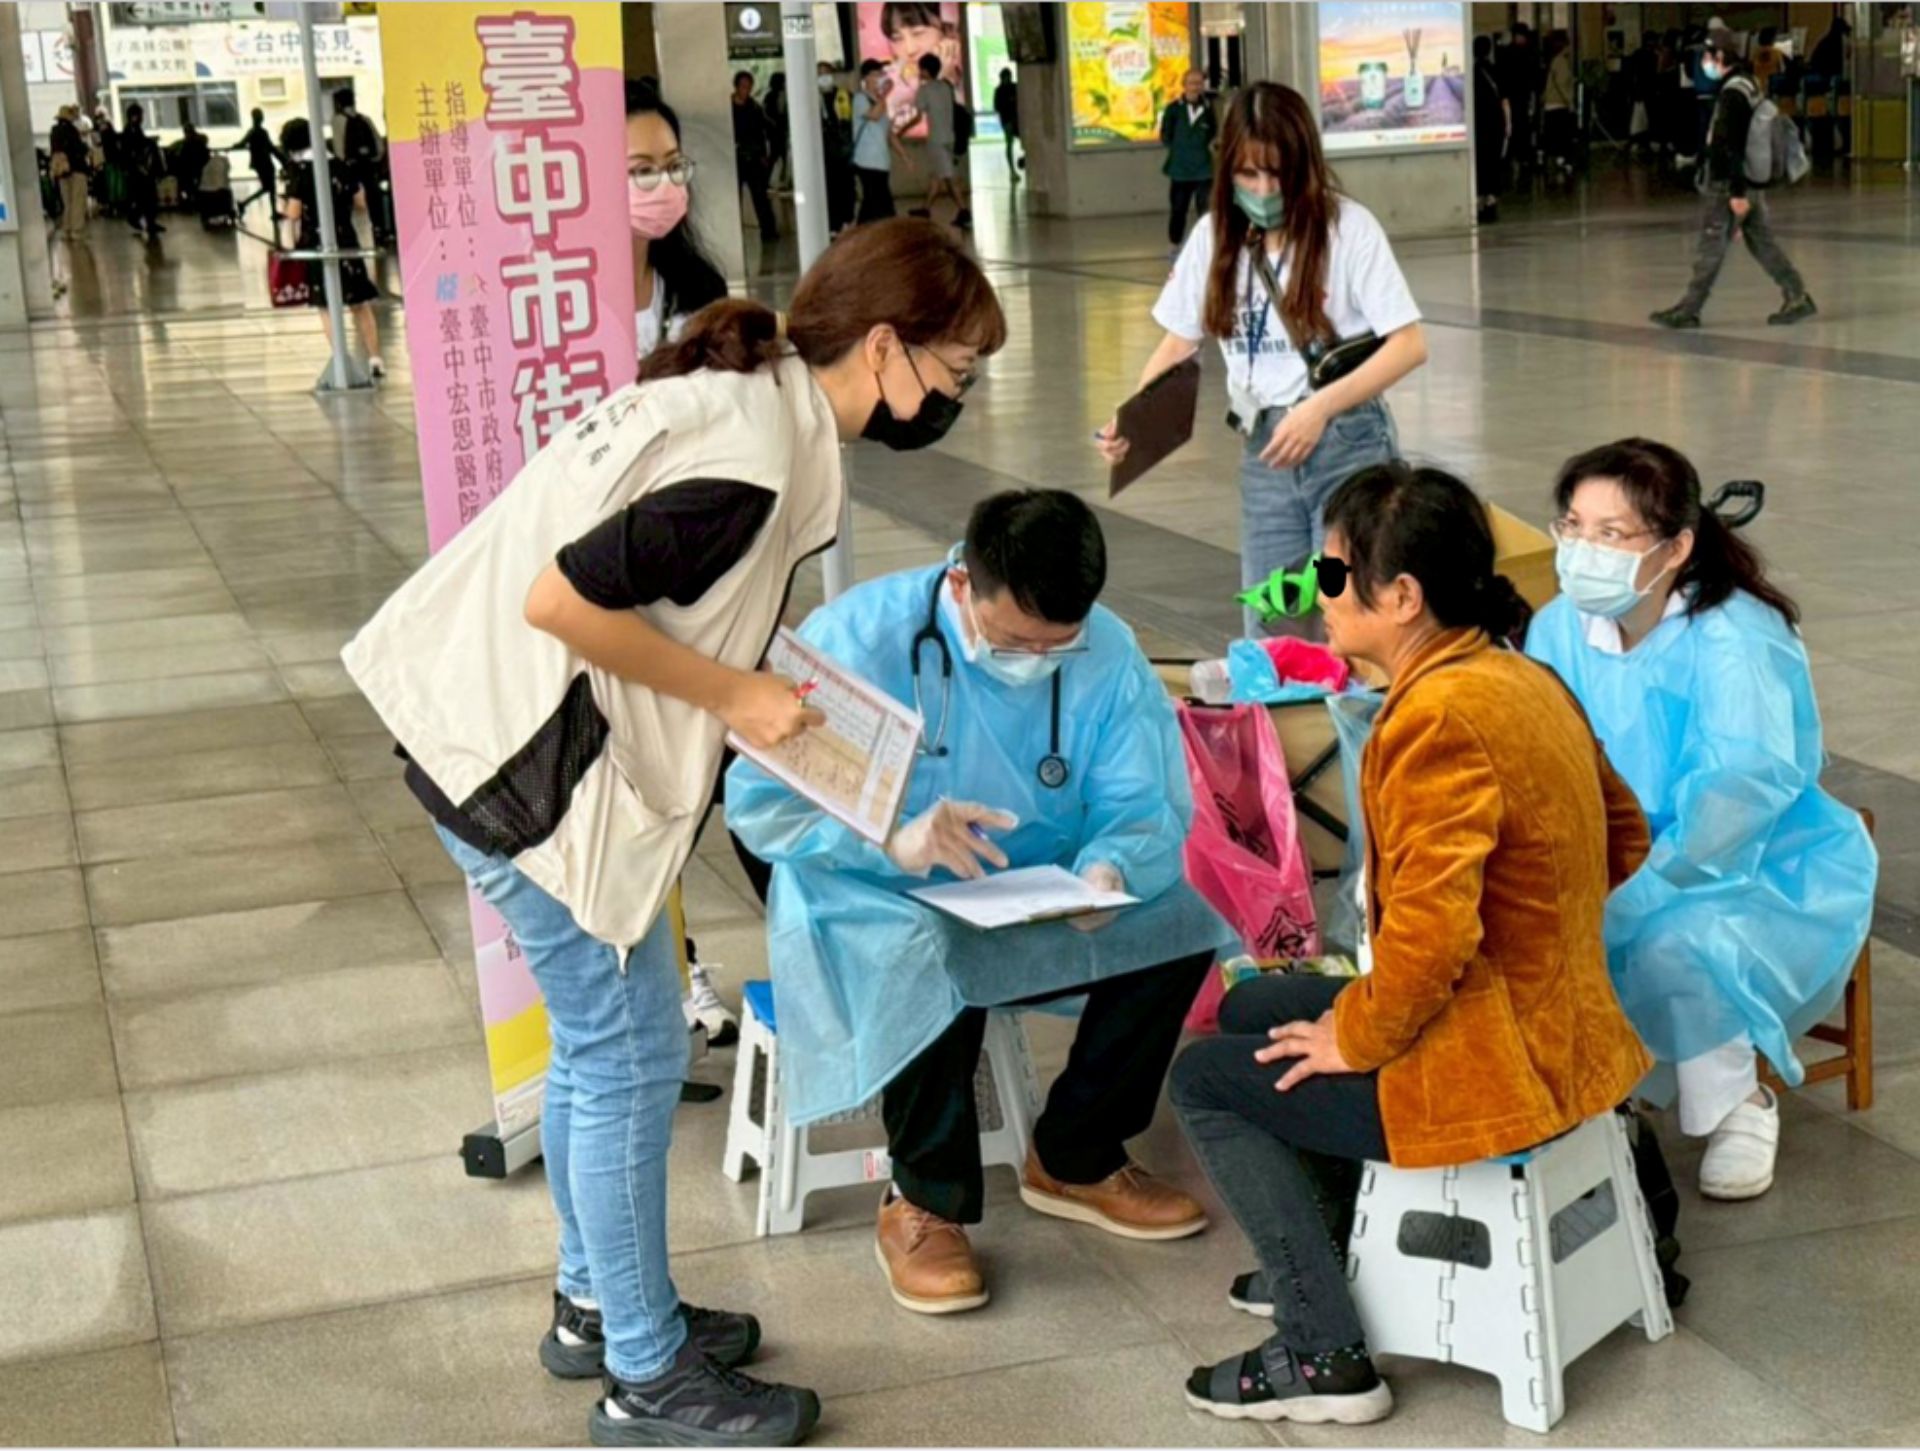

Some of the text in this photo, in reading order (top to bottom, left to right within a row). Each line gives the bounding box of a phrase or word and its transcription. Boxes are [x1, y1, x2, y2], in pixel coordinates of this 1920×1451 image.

[475, 13, 605, 463] 臺中市街
[469, 303, 502, 500] 臺中市政府
